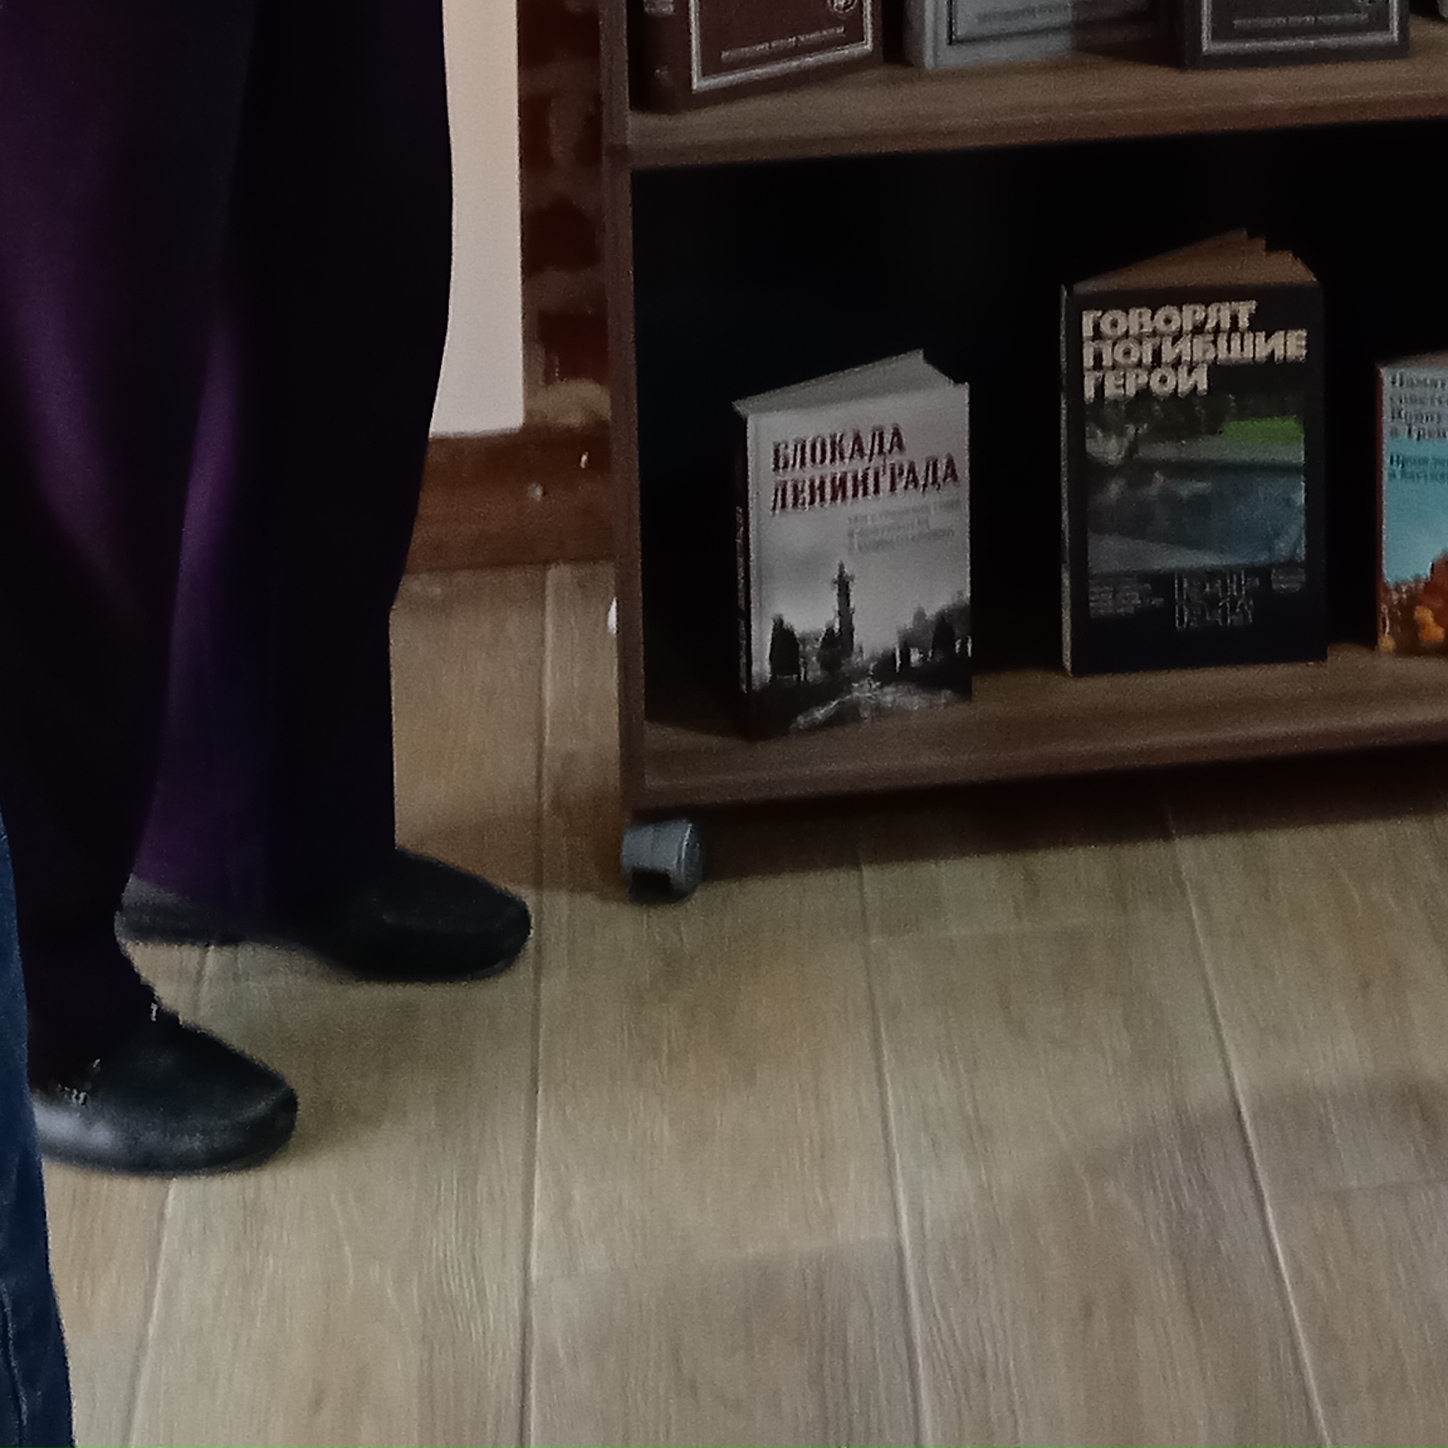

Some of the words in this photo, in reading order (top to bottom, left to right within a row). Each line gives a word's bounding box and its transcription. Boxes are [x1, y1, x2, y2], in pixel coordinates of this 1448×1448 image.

[1082, 300, 1258, 337] ГОВОРЯТ
[1083, 328, 1308, 367] ПОГИБШИЕ
[1083, 363, 1208, 402] ГЕРОИ
[773, 423, 906, 472] БЛОКАДА
[772, 453, 959, 515] ЛЕНИНГРАДА
